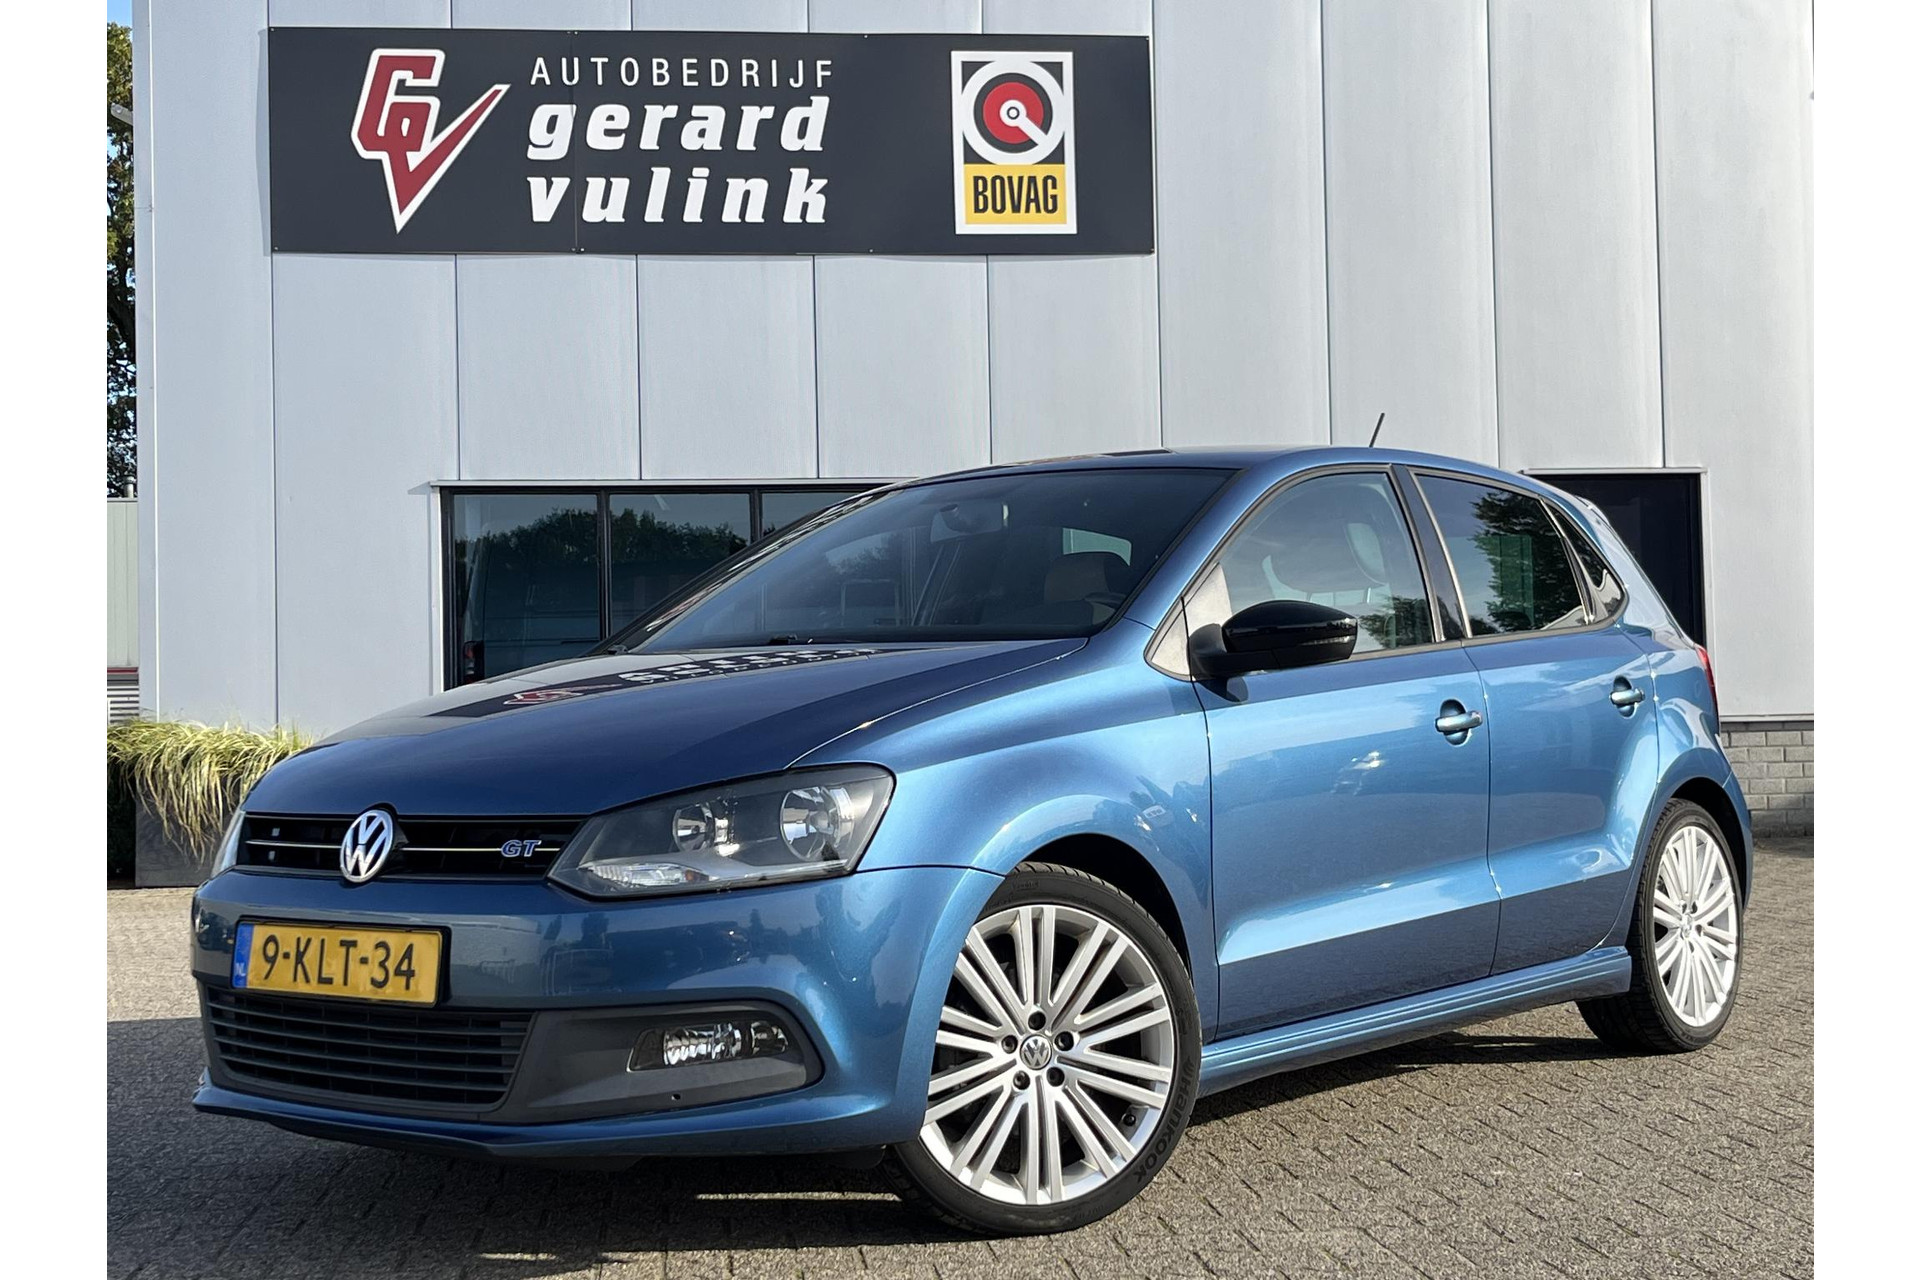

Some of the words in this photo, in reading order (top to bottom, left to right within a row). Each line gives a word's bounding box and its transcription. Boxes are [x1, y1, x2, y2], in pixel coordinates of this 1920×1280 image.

[529, 56, 833, 89] AUTOBEDRIJF
[526, 95, 831, 161] gerard
[526, 166, 829, 224] vulink
[972, 174, 1059, 214] BOVAG
[501, 839, 543, 858] GT
[262, 933, 416, 991] 9-KLT-34
